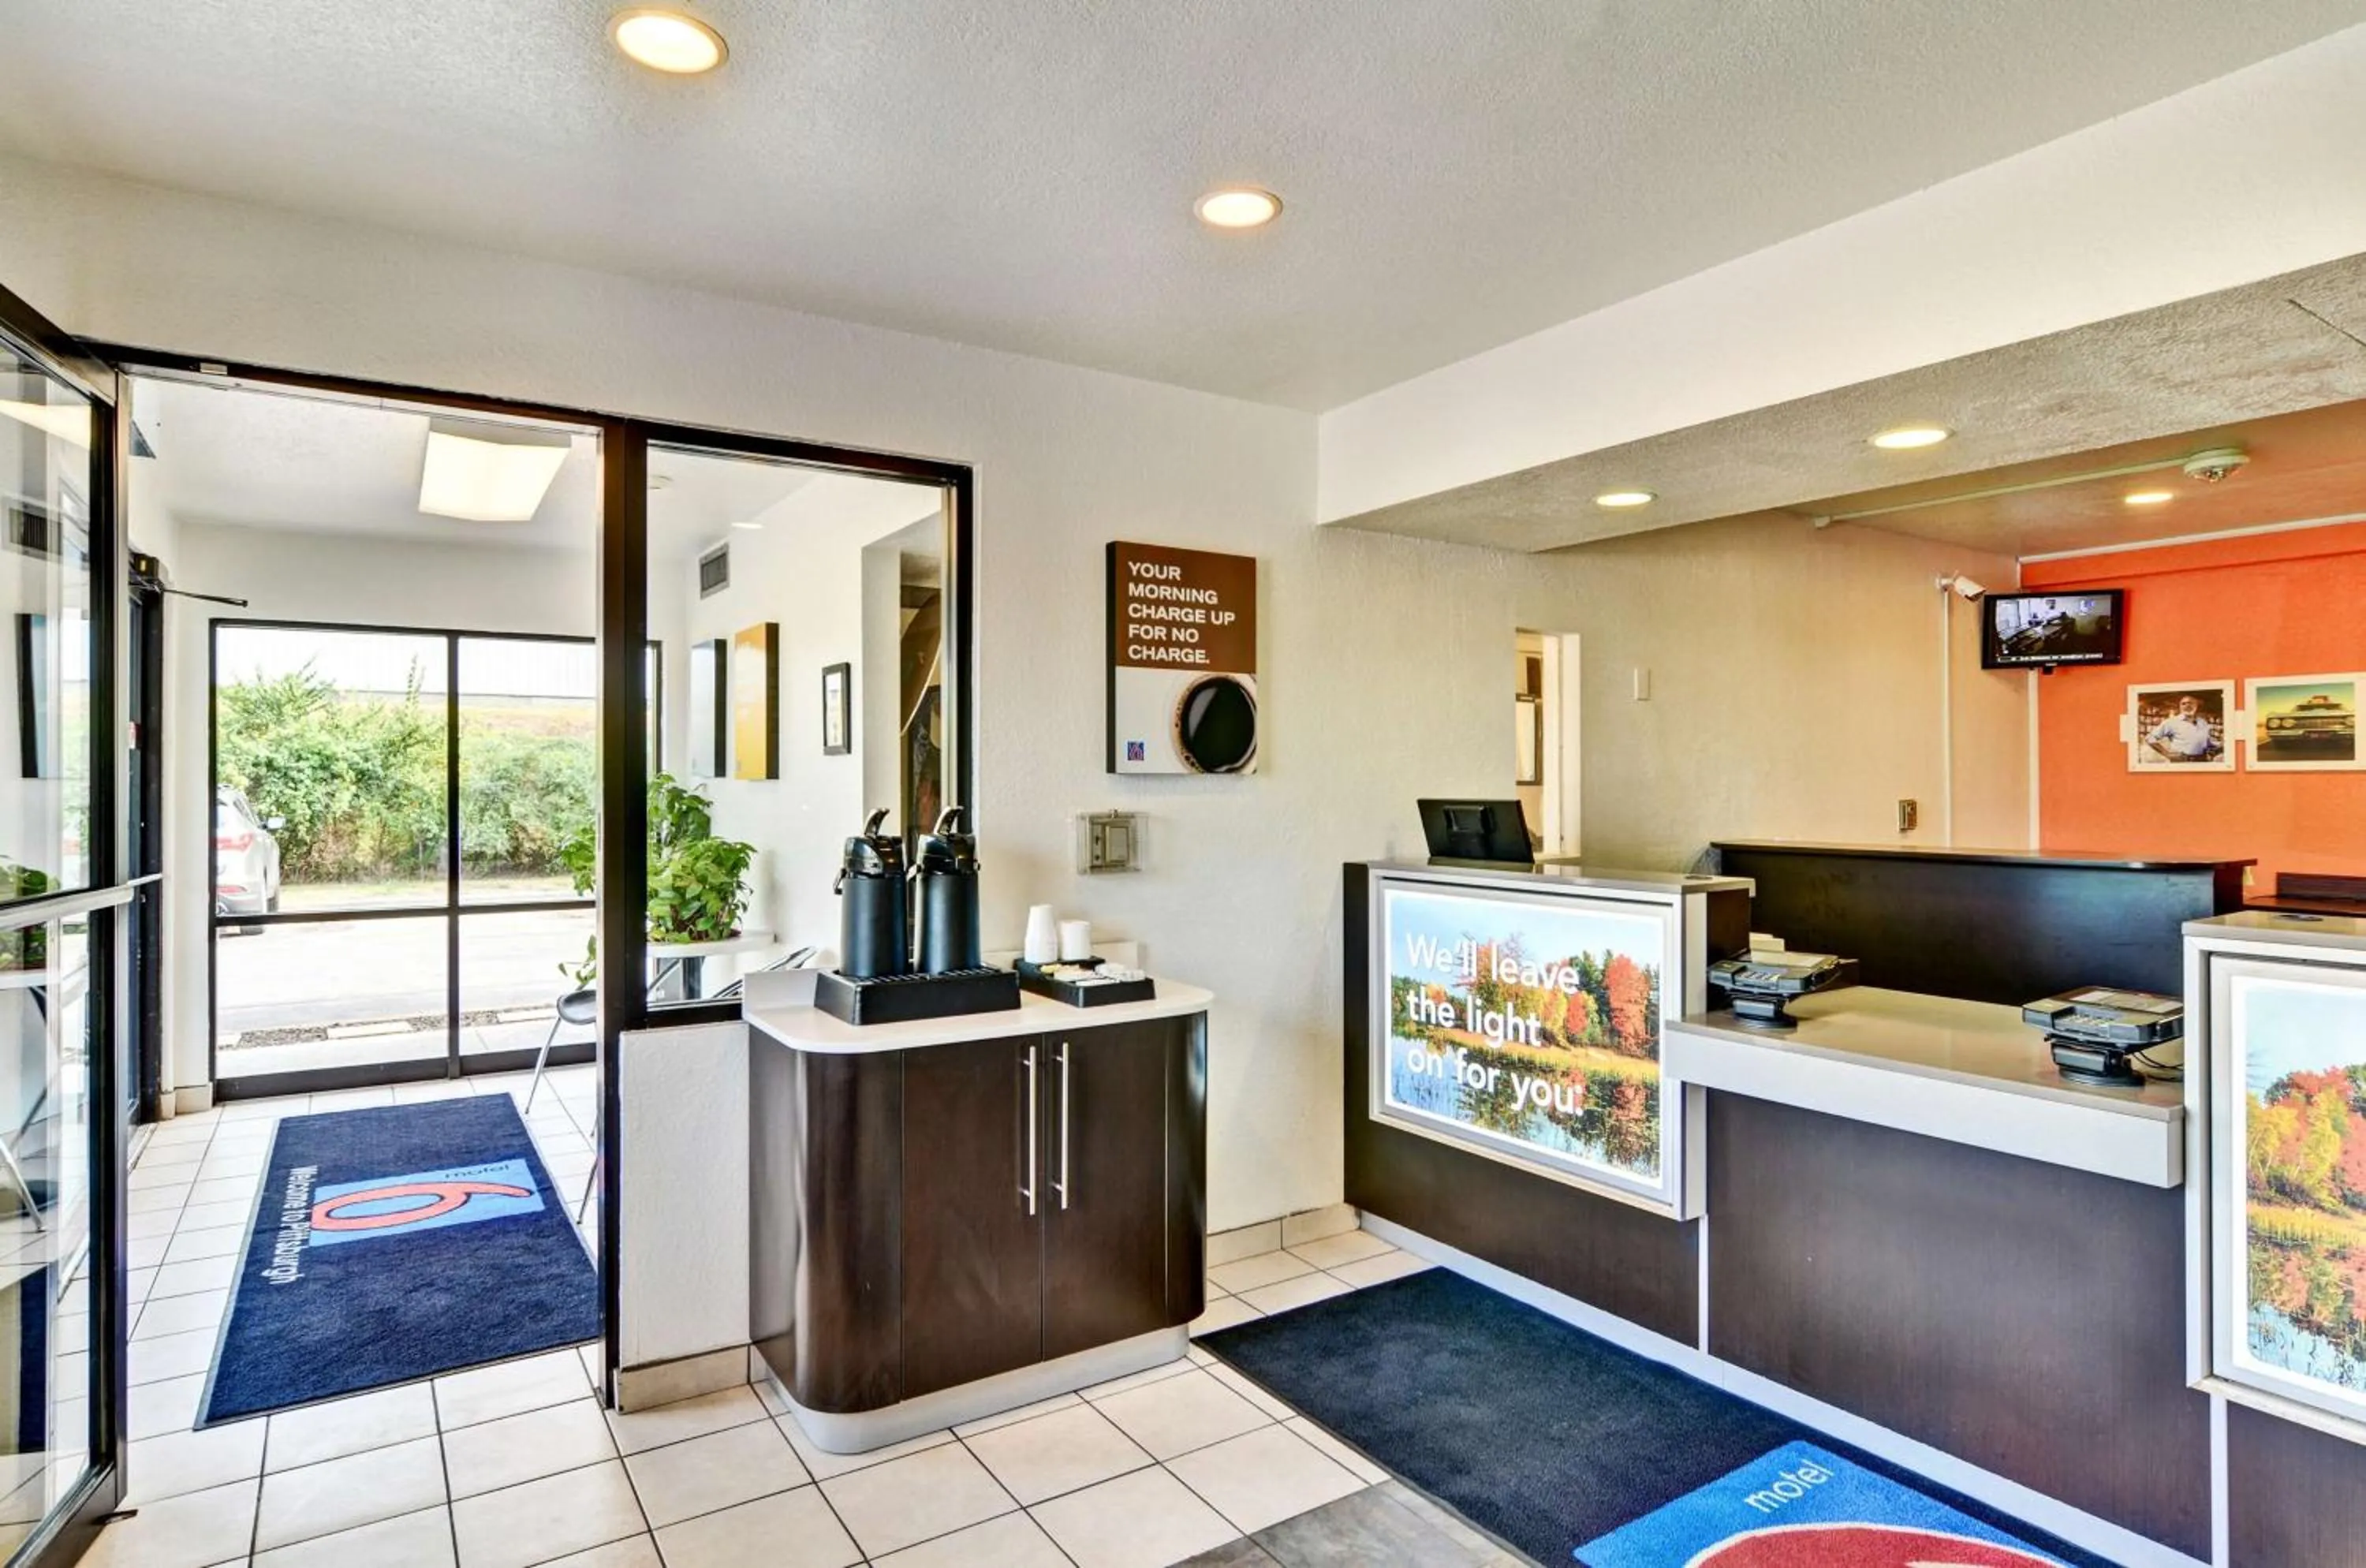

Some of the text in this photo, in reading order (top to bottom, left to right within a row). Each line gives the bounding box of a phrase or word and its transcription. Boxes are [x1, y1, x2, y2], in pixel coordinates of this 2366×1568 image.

[1128, 561, 1181, 581] YOUR
[1128, 583, 1218, 605] MORNING
[1128, 603, 1236, 625] CHARGE UP
[1128, 624, 1199, 643] FOR NO
[1128, 645, 1210, 664] CHARGE.
[1405, 932, 1579, 995] We'll leave
[1407, 987, 1542, 1049] the light
[1407, 1047, 1443, 1079] on
[1454, 1048, 1500, 1093] for
[260, 1165, 319, 1285] Welcome to Pittsburgh
[1744, 1458, 1835, 1514] motel
